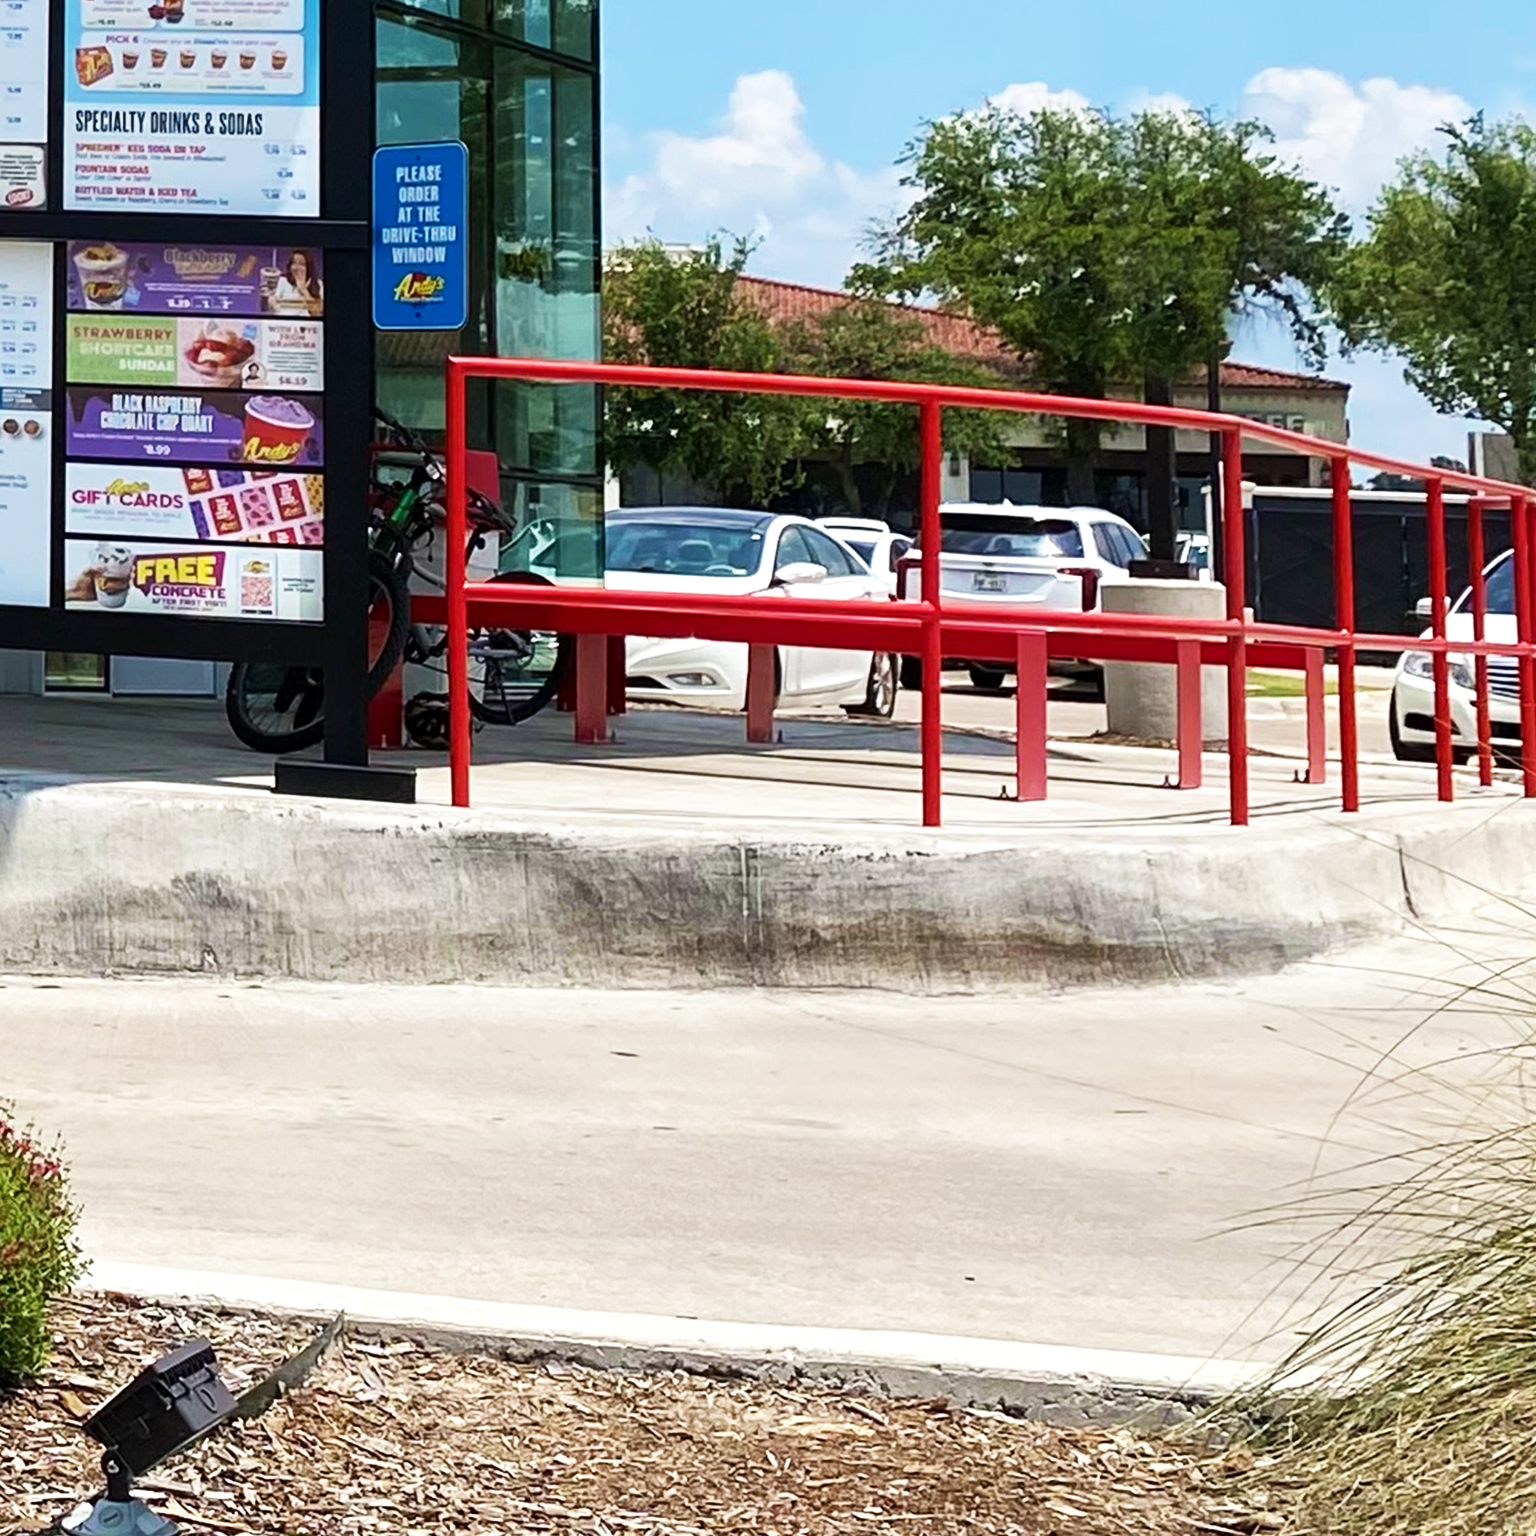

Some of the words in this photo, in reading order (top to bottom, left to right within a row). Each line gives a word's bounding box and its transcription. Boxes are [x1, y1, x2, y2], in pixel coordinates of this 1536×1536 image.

[106, 35, 130, 43] PICK
[133, 36, 139, 44] 6
[75, 110, 146, 133] SPECIALTY
[150, 112, 200, 134] DRINKS
[204, 114, 215, 134] &
[219, 113, 263, 135] SODAS
[147, 144, 171, 152] SODA
[189, 145, 206, 153] TAP
[396, 165, 442, 183] PLEASE
[181, 189, 197, 197] TEA
[399, 185, 439, 203] ORDER
[398, 207, 412, 223] AT
[417, 206, 440, 222] THE
[382, 226, 456, 244] DRIVE-THRU
[164, 248, 236, 267] Blackberry
[392, 246, 447, 263] WINDOW
[393, 273, 445, 301] Andy's
[73, 327, 172, 340] STRAWBERRY
[79, 342, 174, 356] SHORTCAKE
[119, 359, 174, 372] SUNDAE
[112, 394, 143, 412] BLACK
[144, 396, 202, 414] RASPBERRY
[101, 411, 154, 431] CHOCOLATE
[156, 413, 179, 431] CHIP
[181, 415, 213, 433] QUART
[243, 437, 300, 460] Andy's
[72, 490, 112, 505] GIFT
[120, 492, 184, 509] CARDS
[137, 556, 216, 586] FREE
[152, 585, 226, 599] CONCRETE
